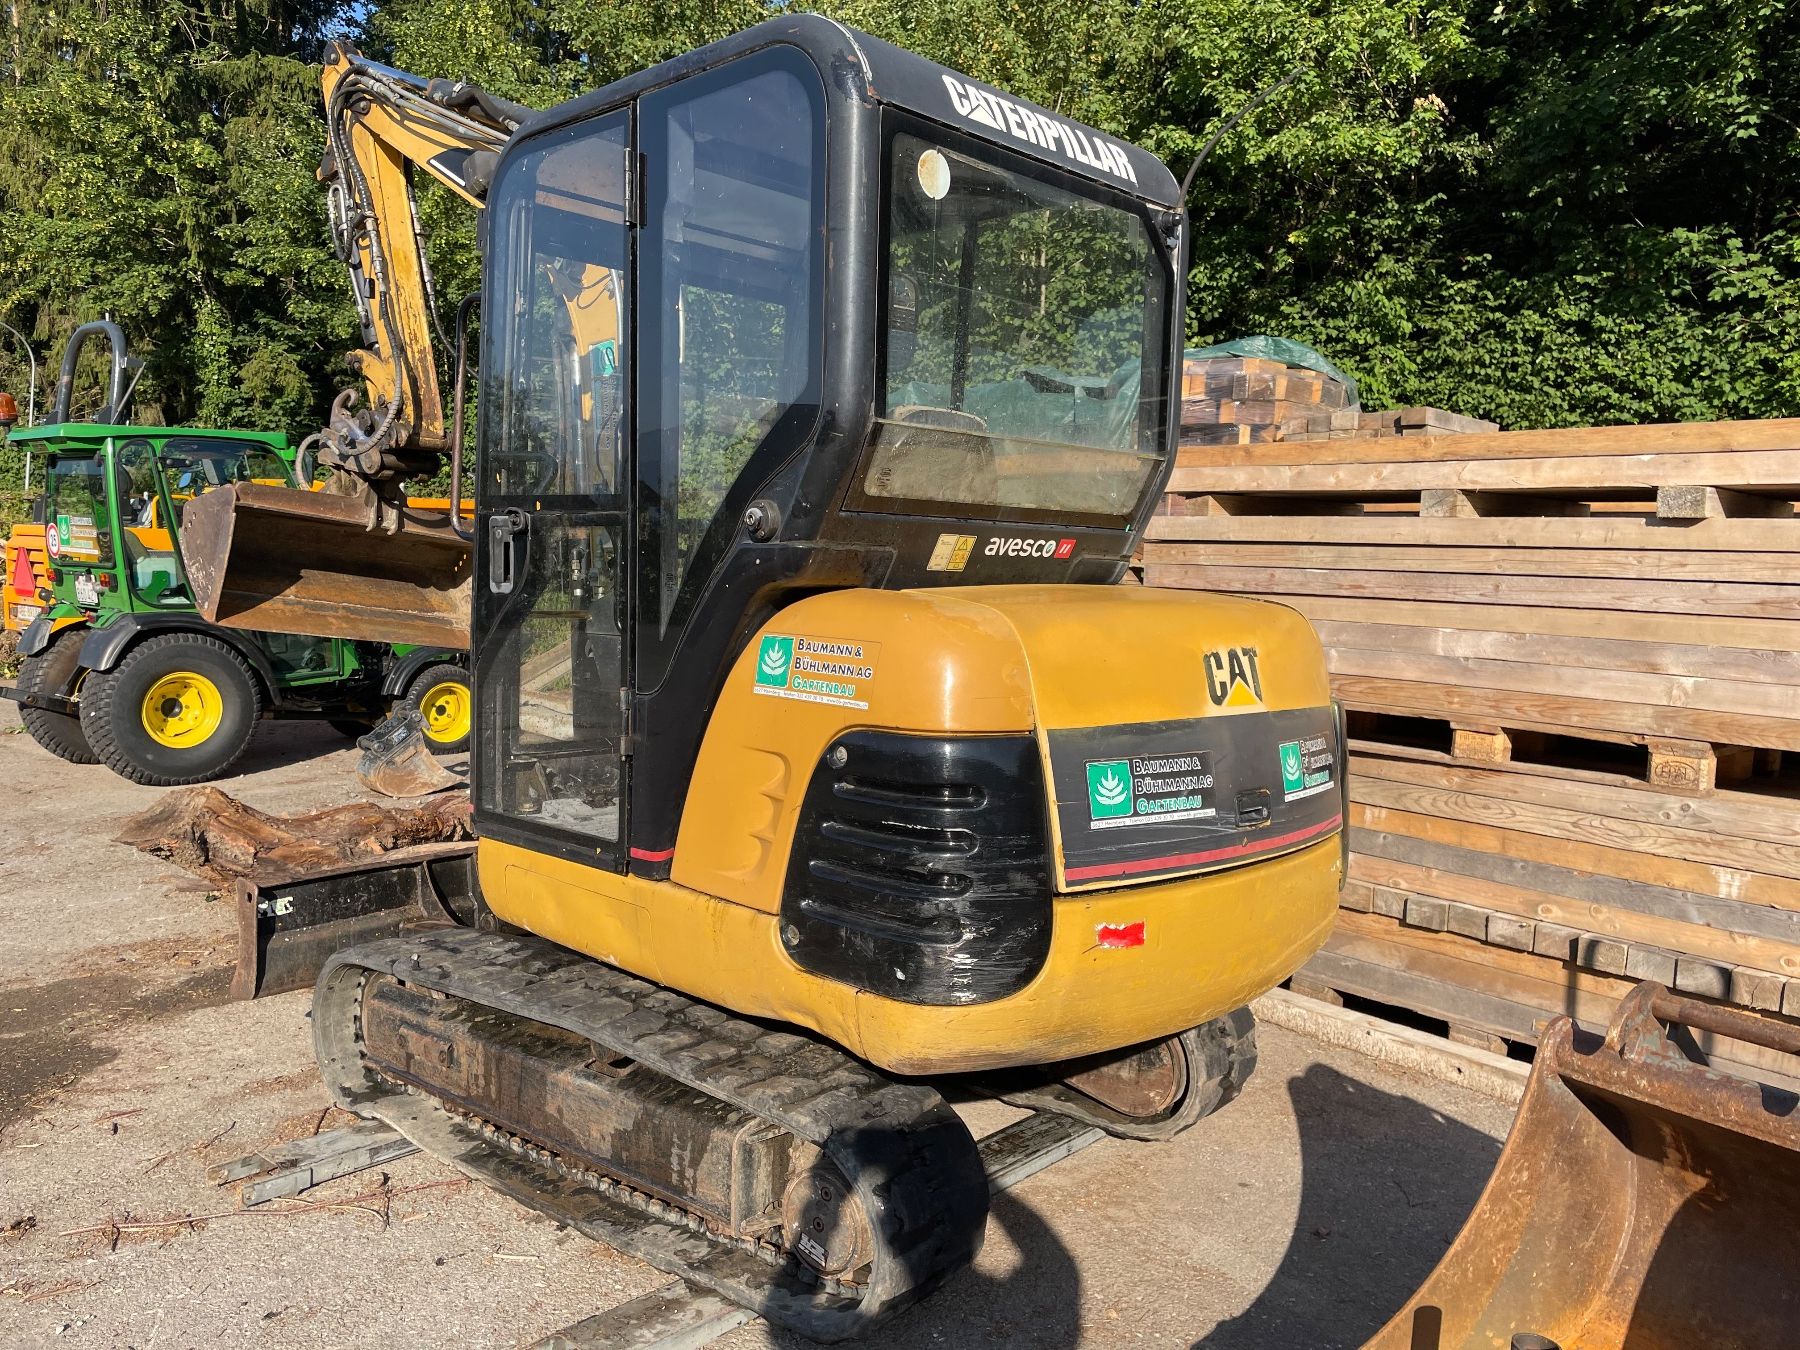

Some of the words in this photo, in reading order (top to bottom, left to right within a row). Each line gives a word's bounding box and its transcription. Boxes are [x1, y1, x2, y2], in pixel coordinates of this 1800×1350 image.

[941, 74, 1139, 189] CATERPILLAR
[984, 537, 1057, 558] avesco
[797, 638, 854, 658] BAUMANN
[854, 646, 864, 659] &
[794, 657, 856, 677] BÜHLMANN
[856, 667, 872, 679] AG
[1203, 647, 1263, 706] CAT
[792, 675, 856, 697] GARTENBAU
[1133, 758, 1191, 775] BAUMANN
[1192, 757, 1202, 770] &
[1135, 775, 1198, 795] BÜHLMANN
[1198, 774, 1214, 789] AG
[1137, 795, 1203, 814] GARTENBAU
